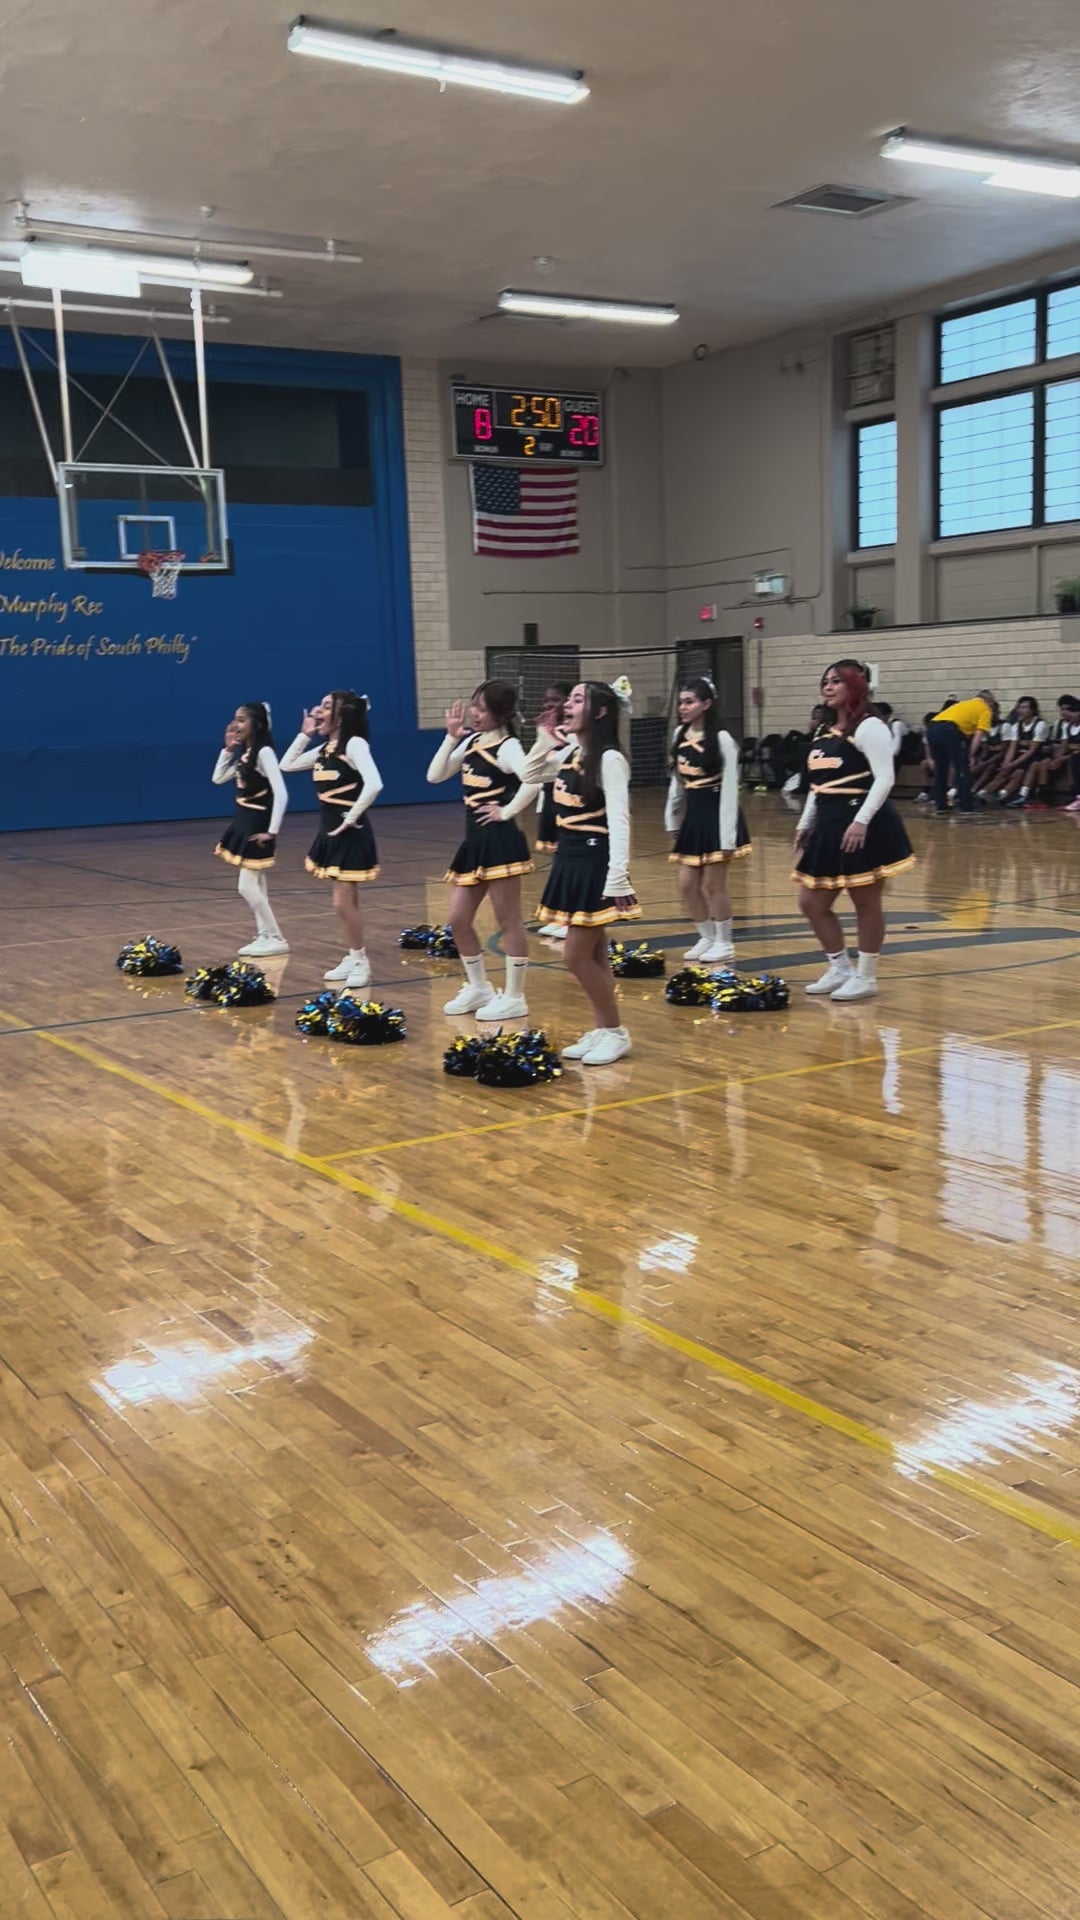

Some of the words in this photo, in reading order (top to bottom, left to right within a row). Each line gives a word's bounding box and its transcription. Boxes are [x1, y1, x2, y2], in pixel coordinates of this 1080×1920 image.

[456, 392, 490, 406] HOME
[564, 400, 599, 412] GUEST
[474, 408, 492, 440] 8
[569, 415, 599, 446] 20
[523, 436, 536, 456] 2
[0, 592, 67, 623] Murphy
[72, 595, 104, 616] Rec
[31, 634, 74, 656] Pride
[76, 635, 96, 660] of
[95, 633, 141, 656] South
